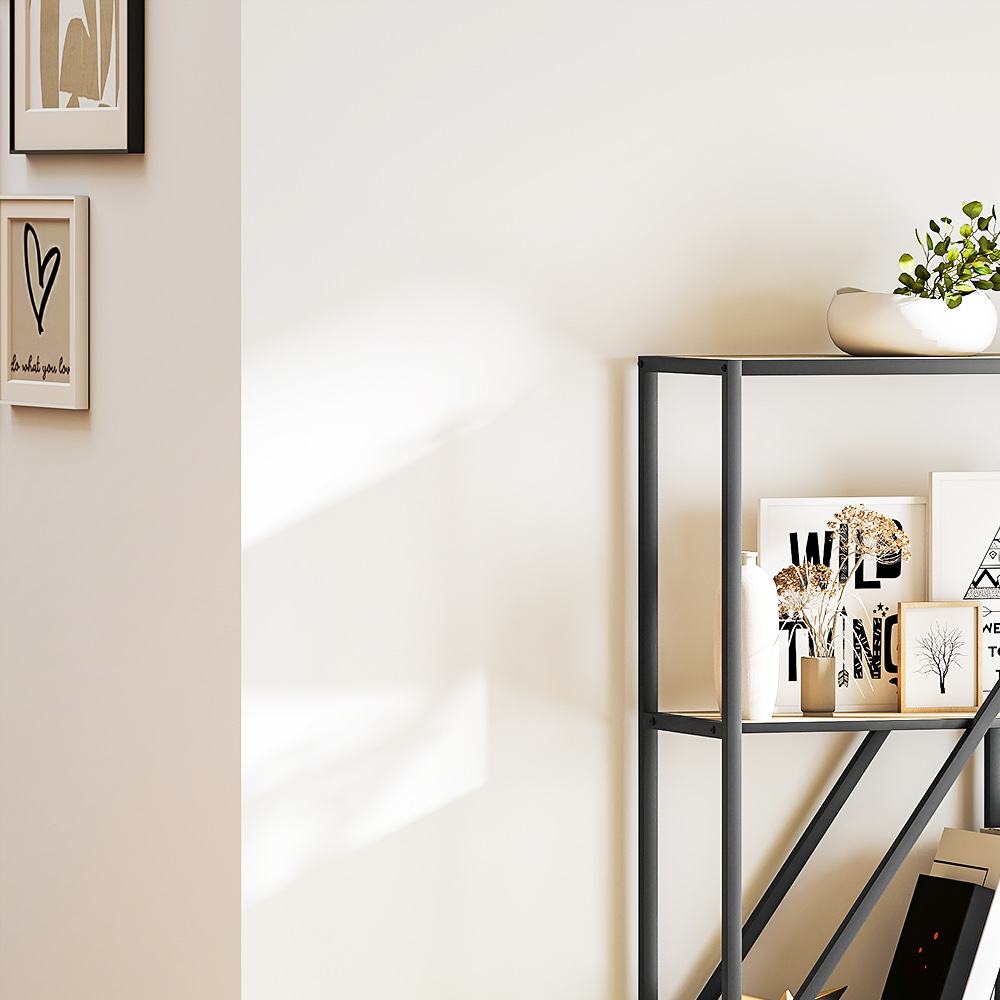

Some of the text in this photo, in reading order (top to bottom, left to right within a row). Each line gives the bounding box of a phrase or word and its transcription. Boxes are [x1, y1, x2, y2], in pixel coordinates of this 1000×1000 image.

[22, 355, 41, 373] what
[42, 364, 57, 380] you
[59, 356, 70, 375] lov
